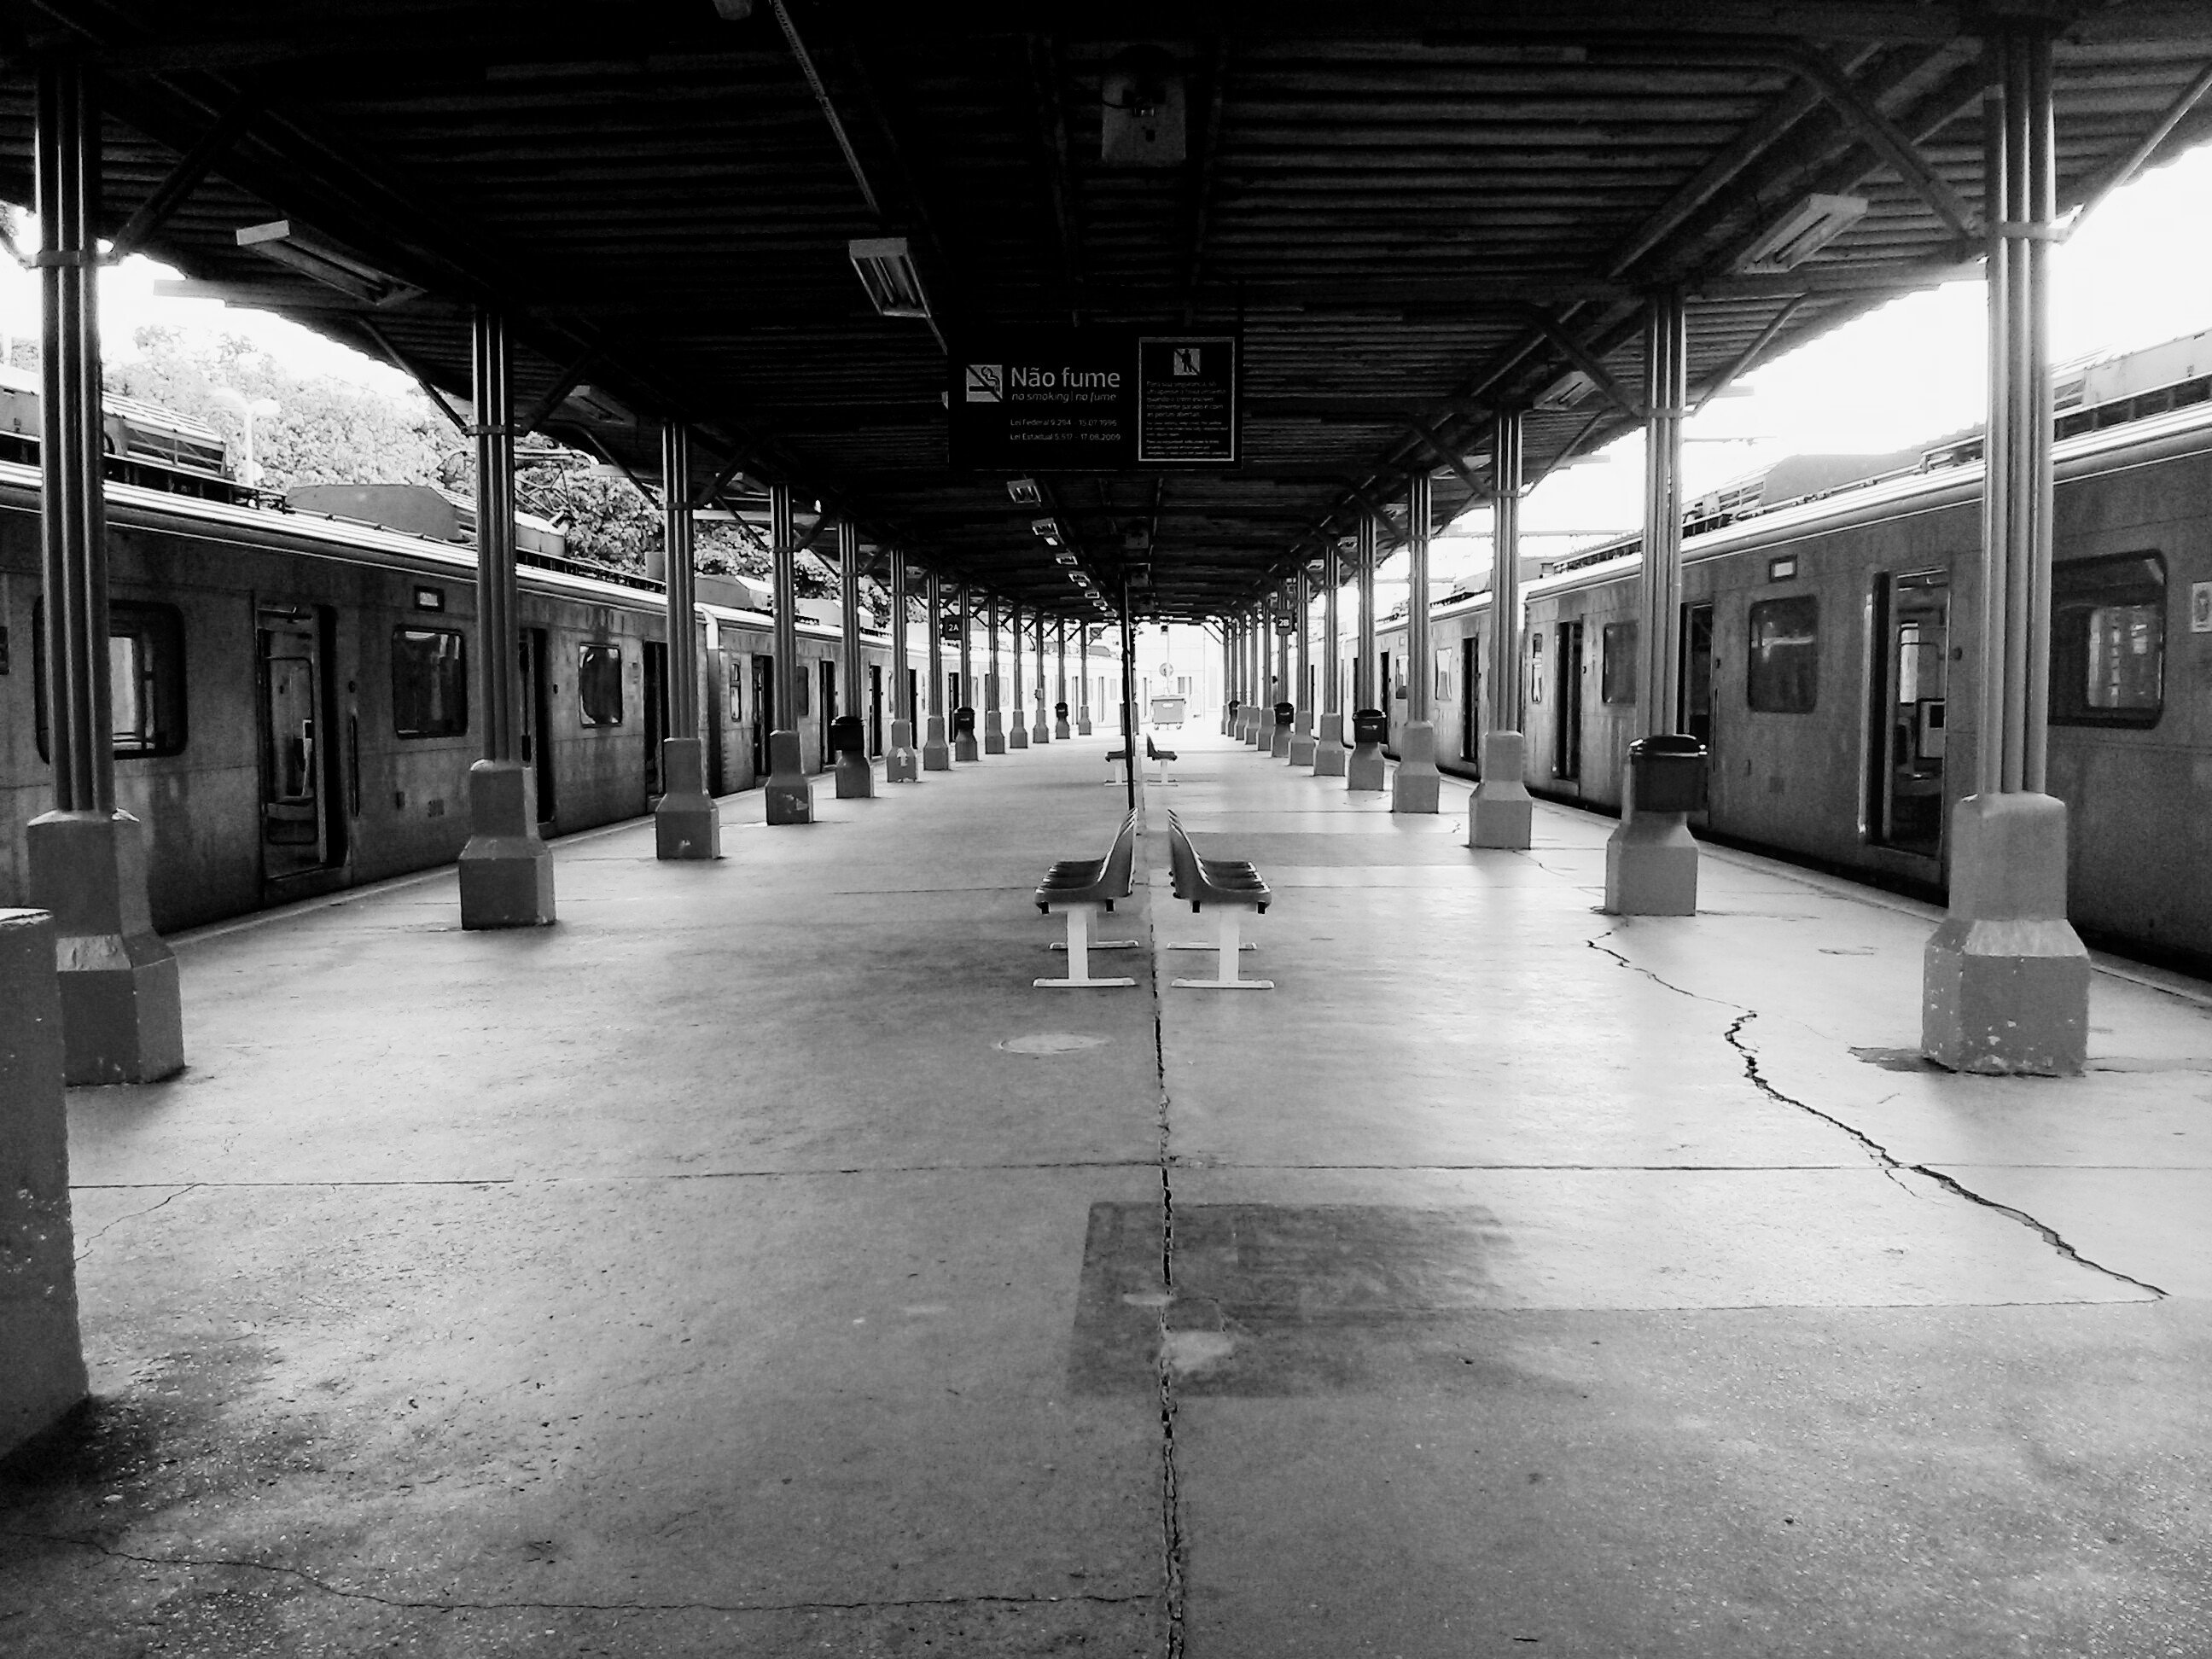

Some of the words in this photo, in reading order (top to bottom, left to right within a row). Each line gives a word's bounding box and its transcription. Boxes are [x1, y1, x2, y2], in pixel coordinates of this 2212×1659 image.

[1010, 367, 1056, 387] Não
[1062, 367, 1121, 387] fume
[1011, 393, 1025, 401] no
[1027, 392, 1069, 404] smoking
[1075, 393, 1088, 401] no
[1090, 392, 1117, 404] fume
[948, 623, 959, 632] 2A
[1278, 619, 1289, 627] 2B
